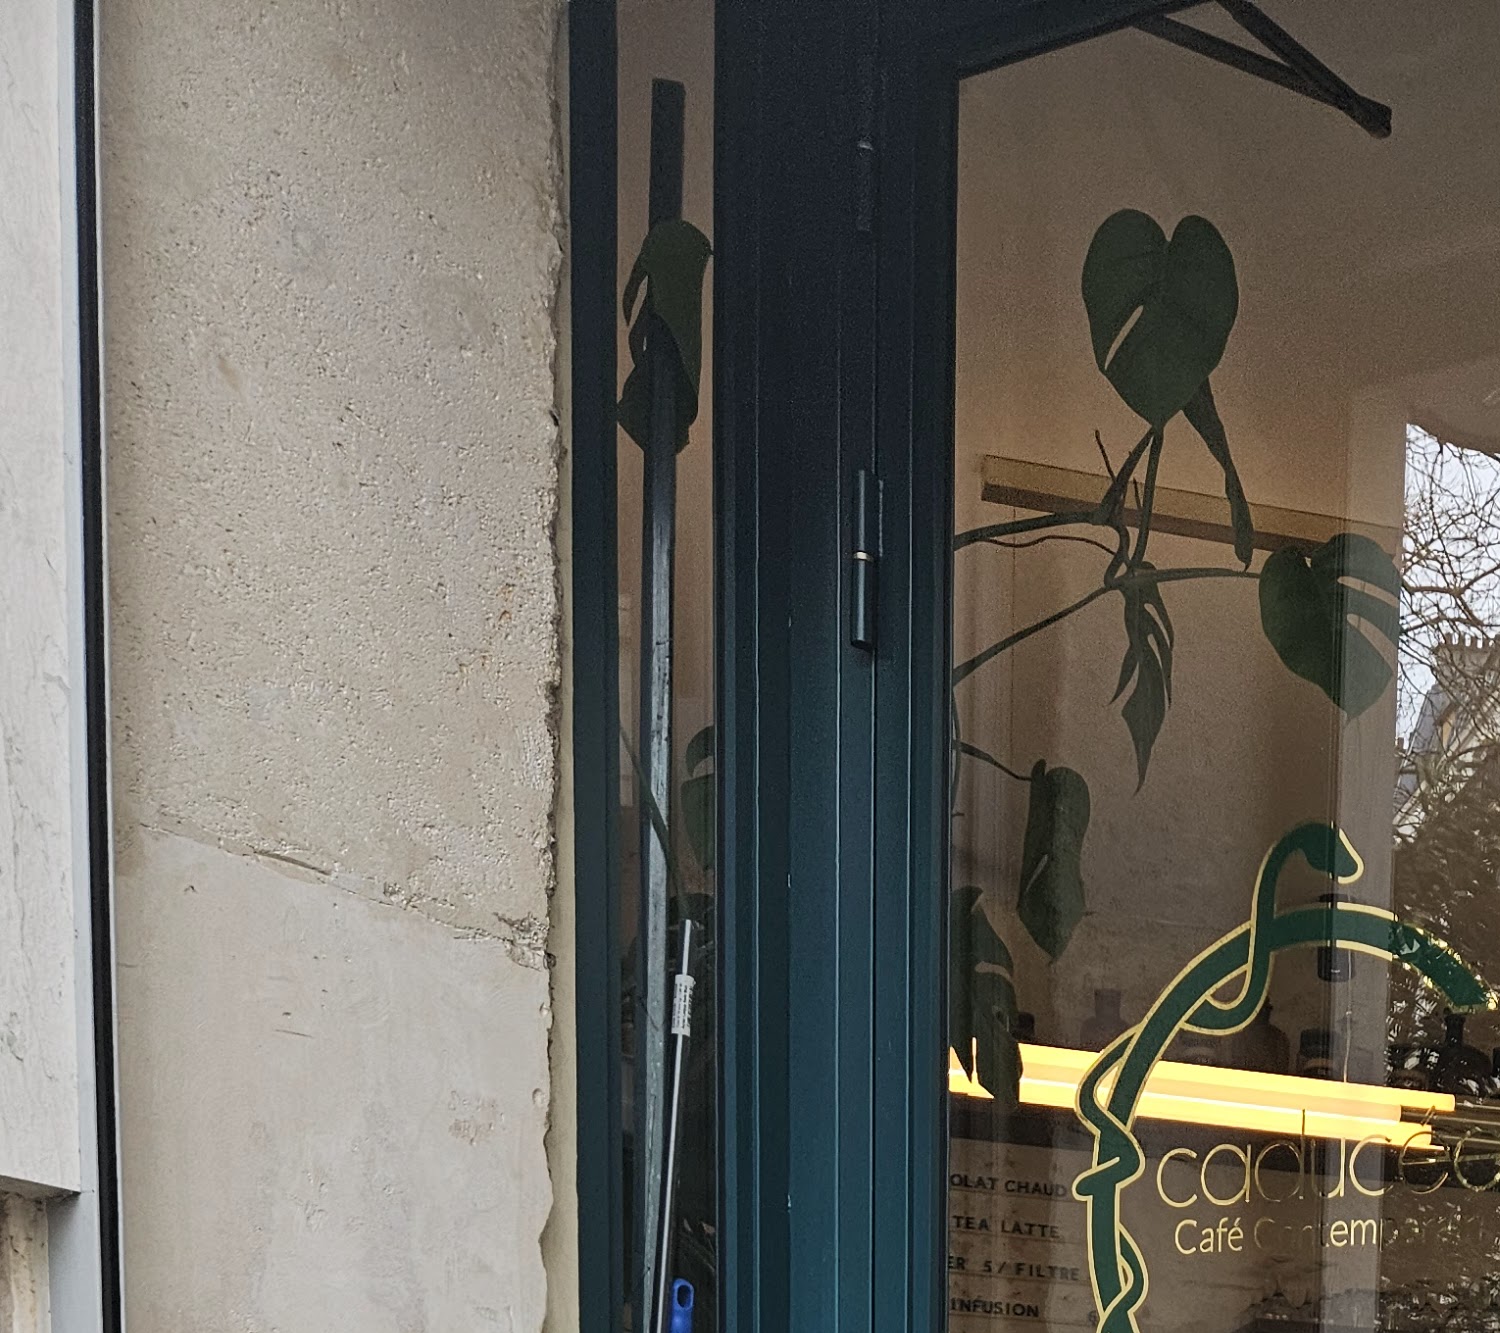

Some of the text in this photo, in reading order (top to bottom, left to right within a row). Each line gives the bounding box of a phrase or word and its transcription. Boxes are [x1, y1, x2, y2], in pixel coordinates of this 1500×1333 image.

[1004, 1179, 1067, 1198] CHAUD
[953, 1215, 1061, 1239] TEA LATTE
[1174, 1216, 1244, 1255] Café
[1015, 1262, 1081, 1281] FILTRE
